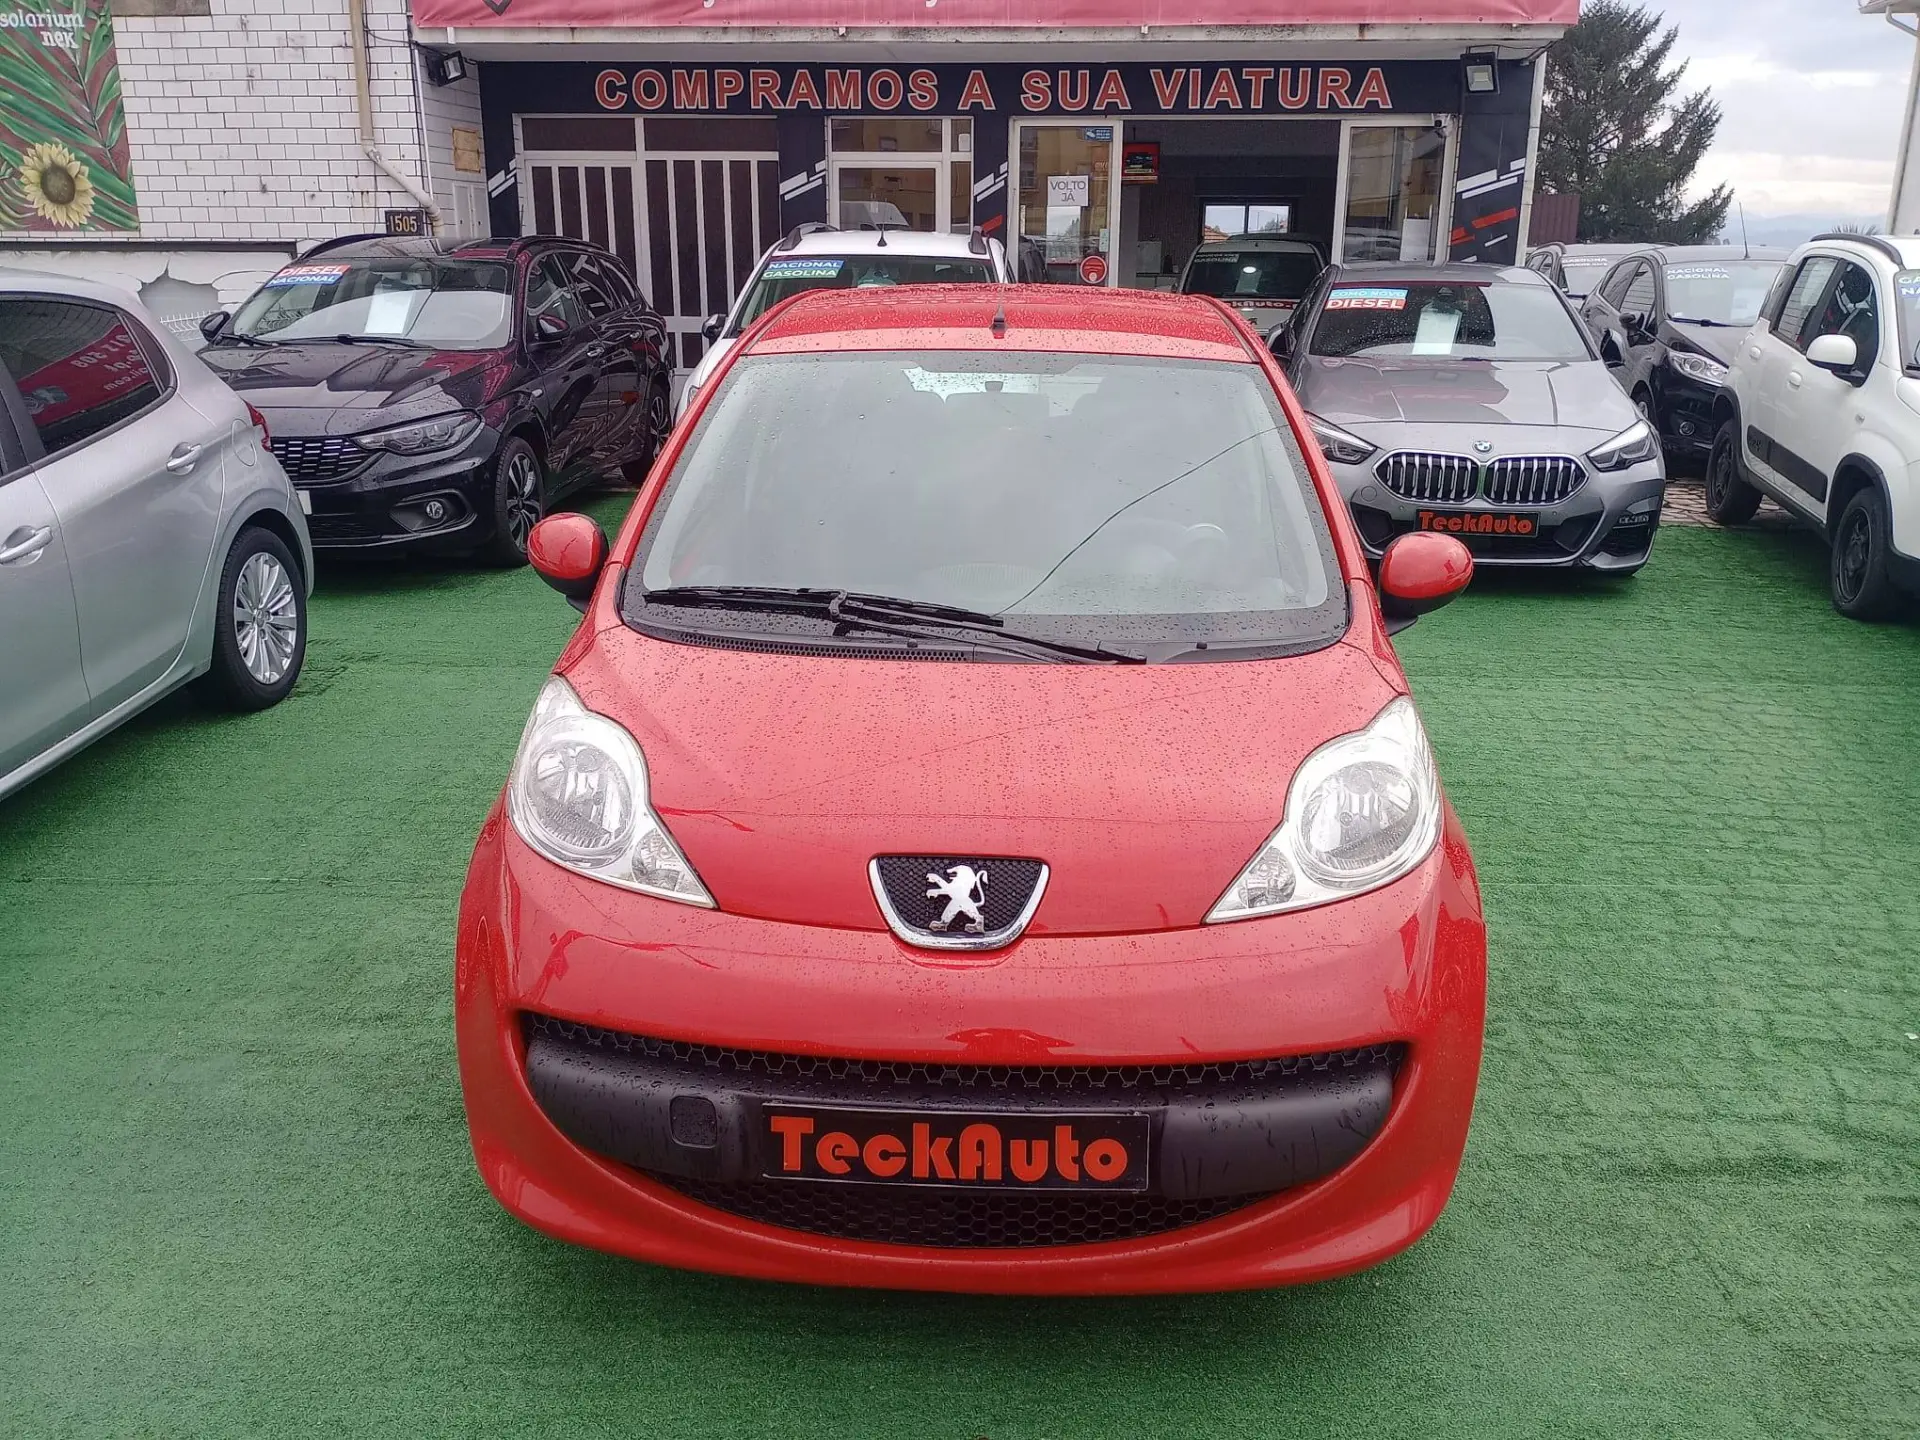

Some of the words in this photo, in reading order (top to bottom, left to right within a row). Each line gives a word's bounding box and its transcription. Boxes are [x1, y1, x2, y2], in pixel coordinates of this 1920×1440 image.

[0, 9, 84, 28] solarium
[595, 69, 938, 110] COMPRAMOS
[957, 69, 996, 110] A
[1020, 69, 1132, 111] SUA
[1150, 68, 1393, 110] VIATURA
[1050, 180, 1087, 192] VOLTO
[1061, 189, 1075, 202] JÁ
[390, 213, 418, 233] 1505
[279, 265, 342, 277] DIESEL
[768, 261, 841, 269] NACIONAL
[269, 275, 335, 285] NACIONAL
[763, 270, 837, 278] GASOLINA
[1332, 290, 1367, 298] COMO
[1370, 290, 1406, 298] NOVO
[1327, 299, 1404, 309] DIESEL
[1419, 512, 1532, 534] TeckAuto
[770, 1115, 1128, 1182] TeckAuto
